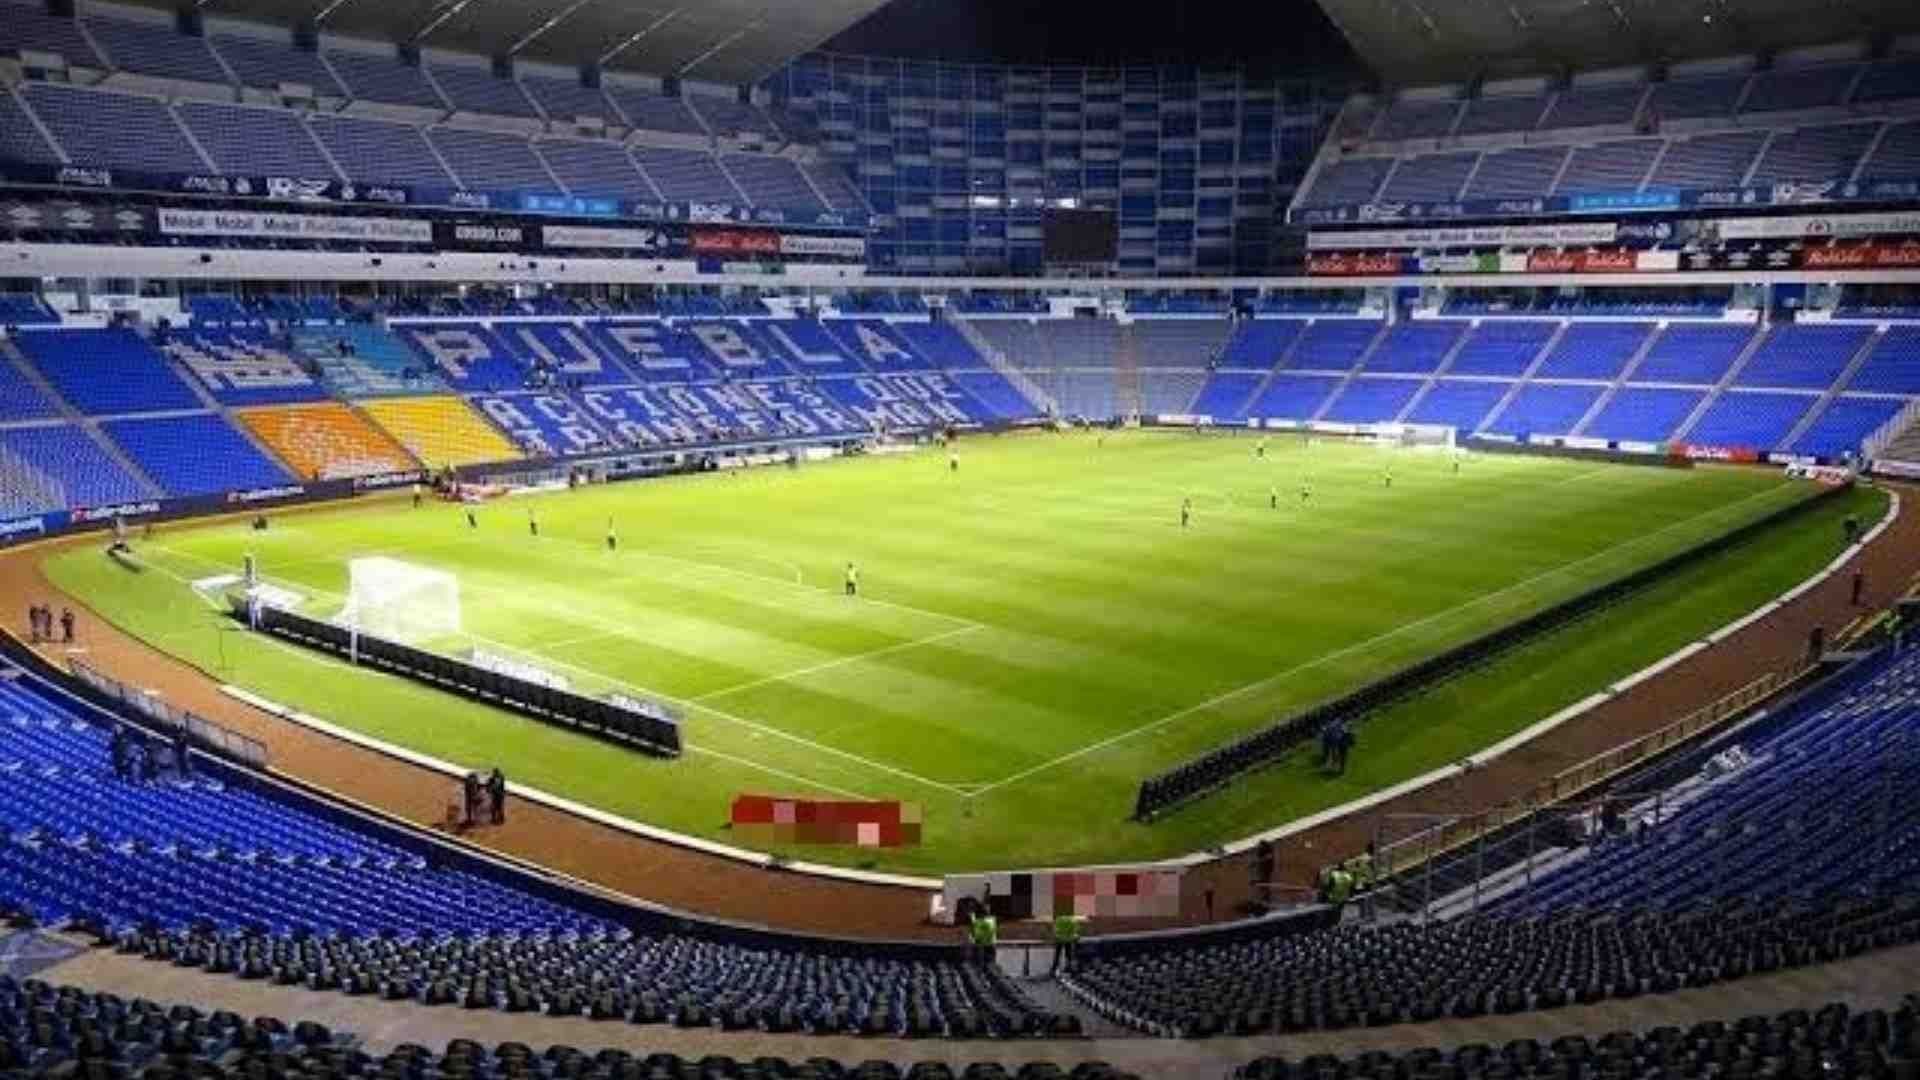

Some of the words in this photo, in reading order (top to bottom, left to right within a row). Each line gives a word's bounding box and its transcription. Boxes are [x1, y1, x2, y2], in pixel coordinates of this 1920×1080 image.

[413, 323, 911, 378] PUEBLA
[482, 380, 823, 427] ACCIONES
[854, 373, 965, 402] QUE
